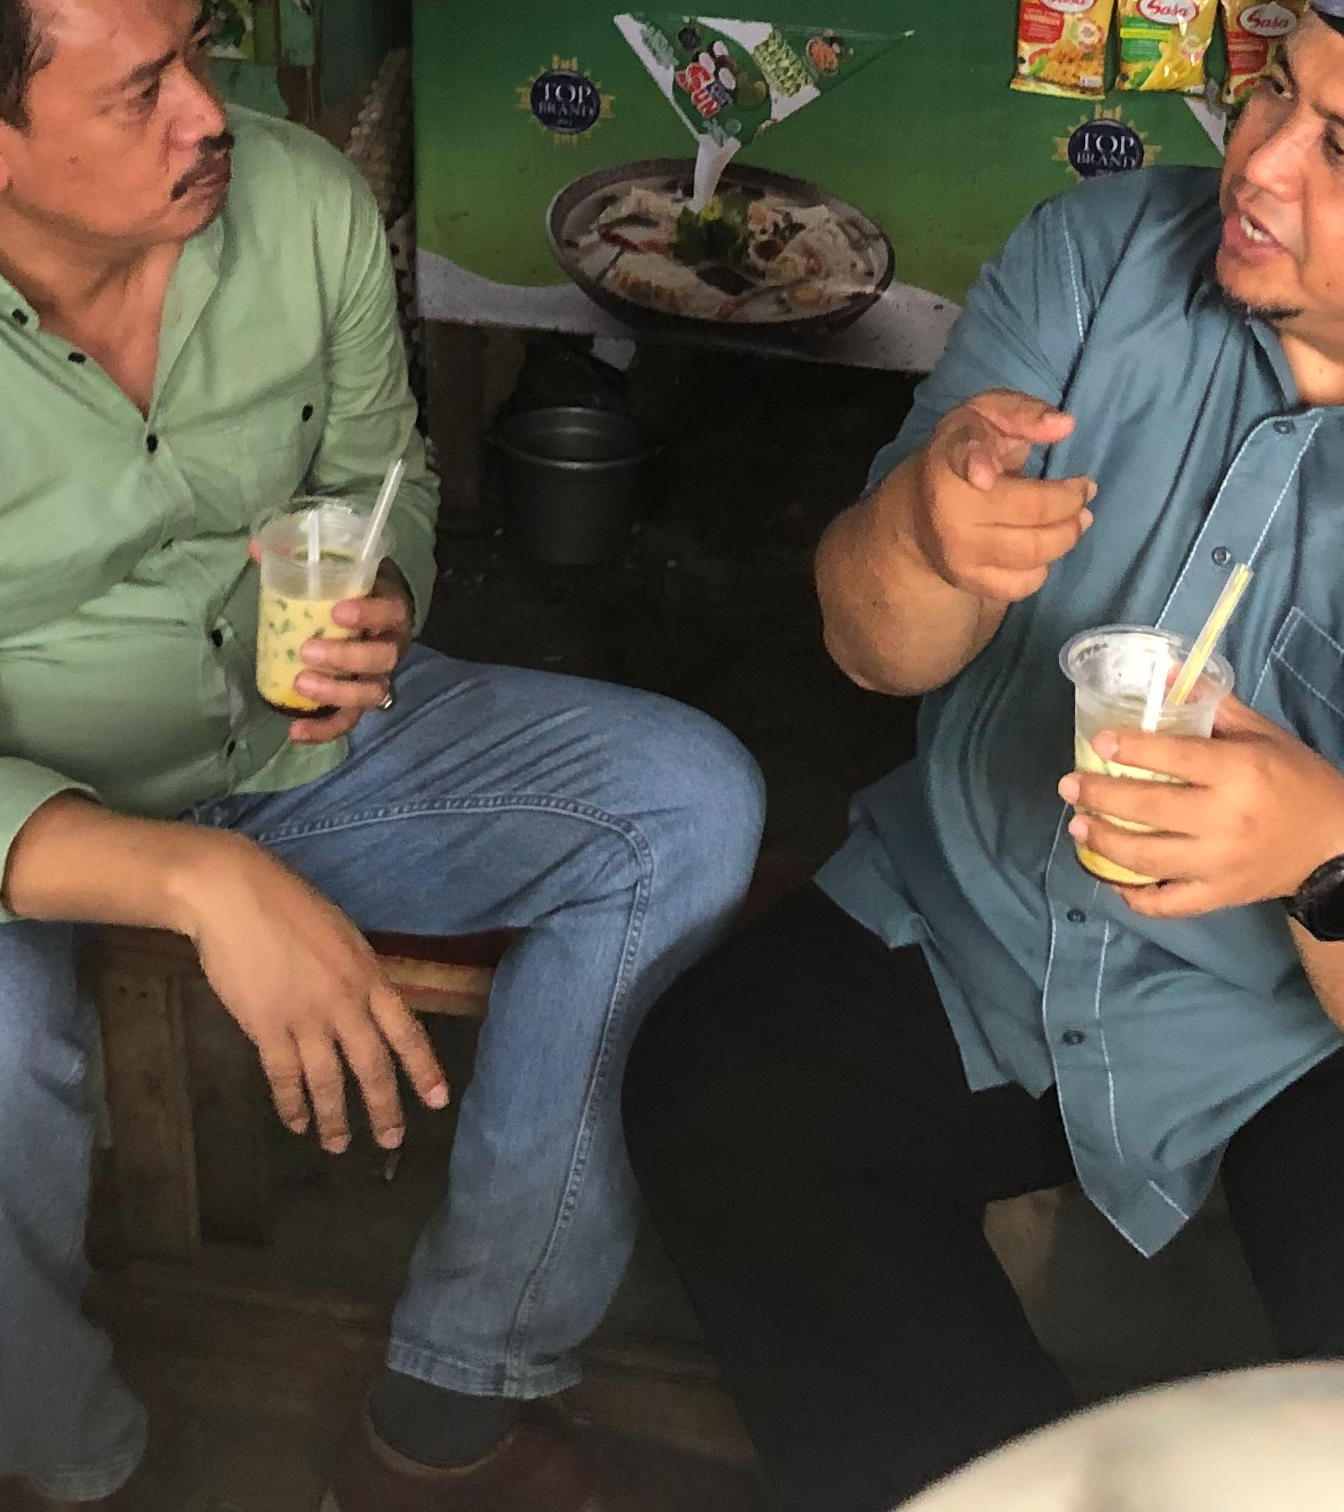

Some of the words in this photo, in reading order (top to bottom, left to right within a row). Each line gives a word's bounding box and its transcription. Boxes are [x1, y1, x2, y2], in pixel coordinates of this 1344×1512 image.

[1246, 7, 1289, 30] Sasa
[537, 81, 593, 104] TOP
[1076, 131, 1136, 155] TOP
